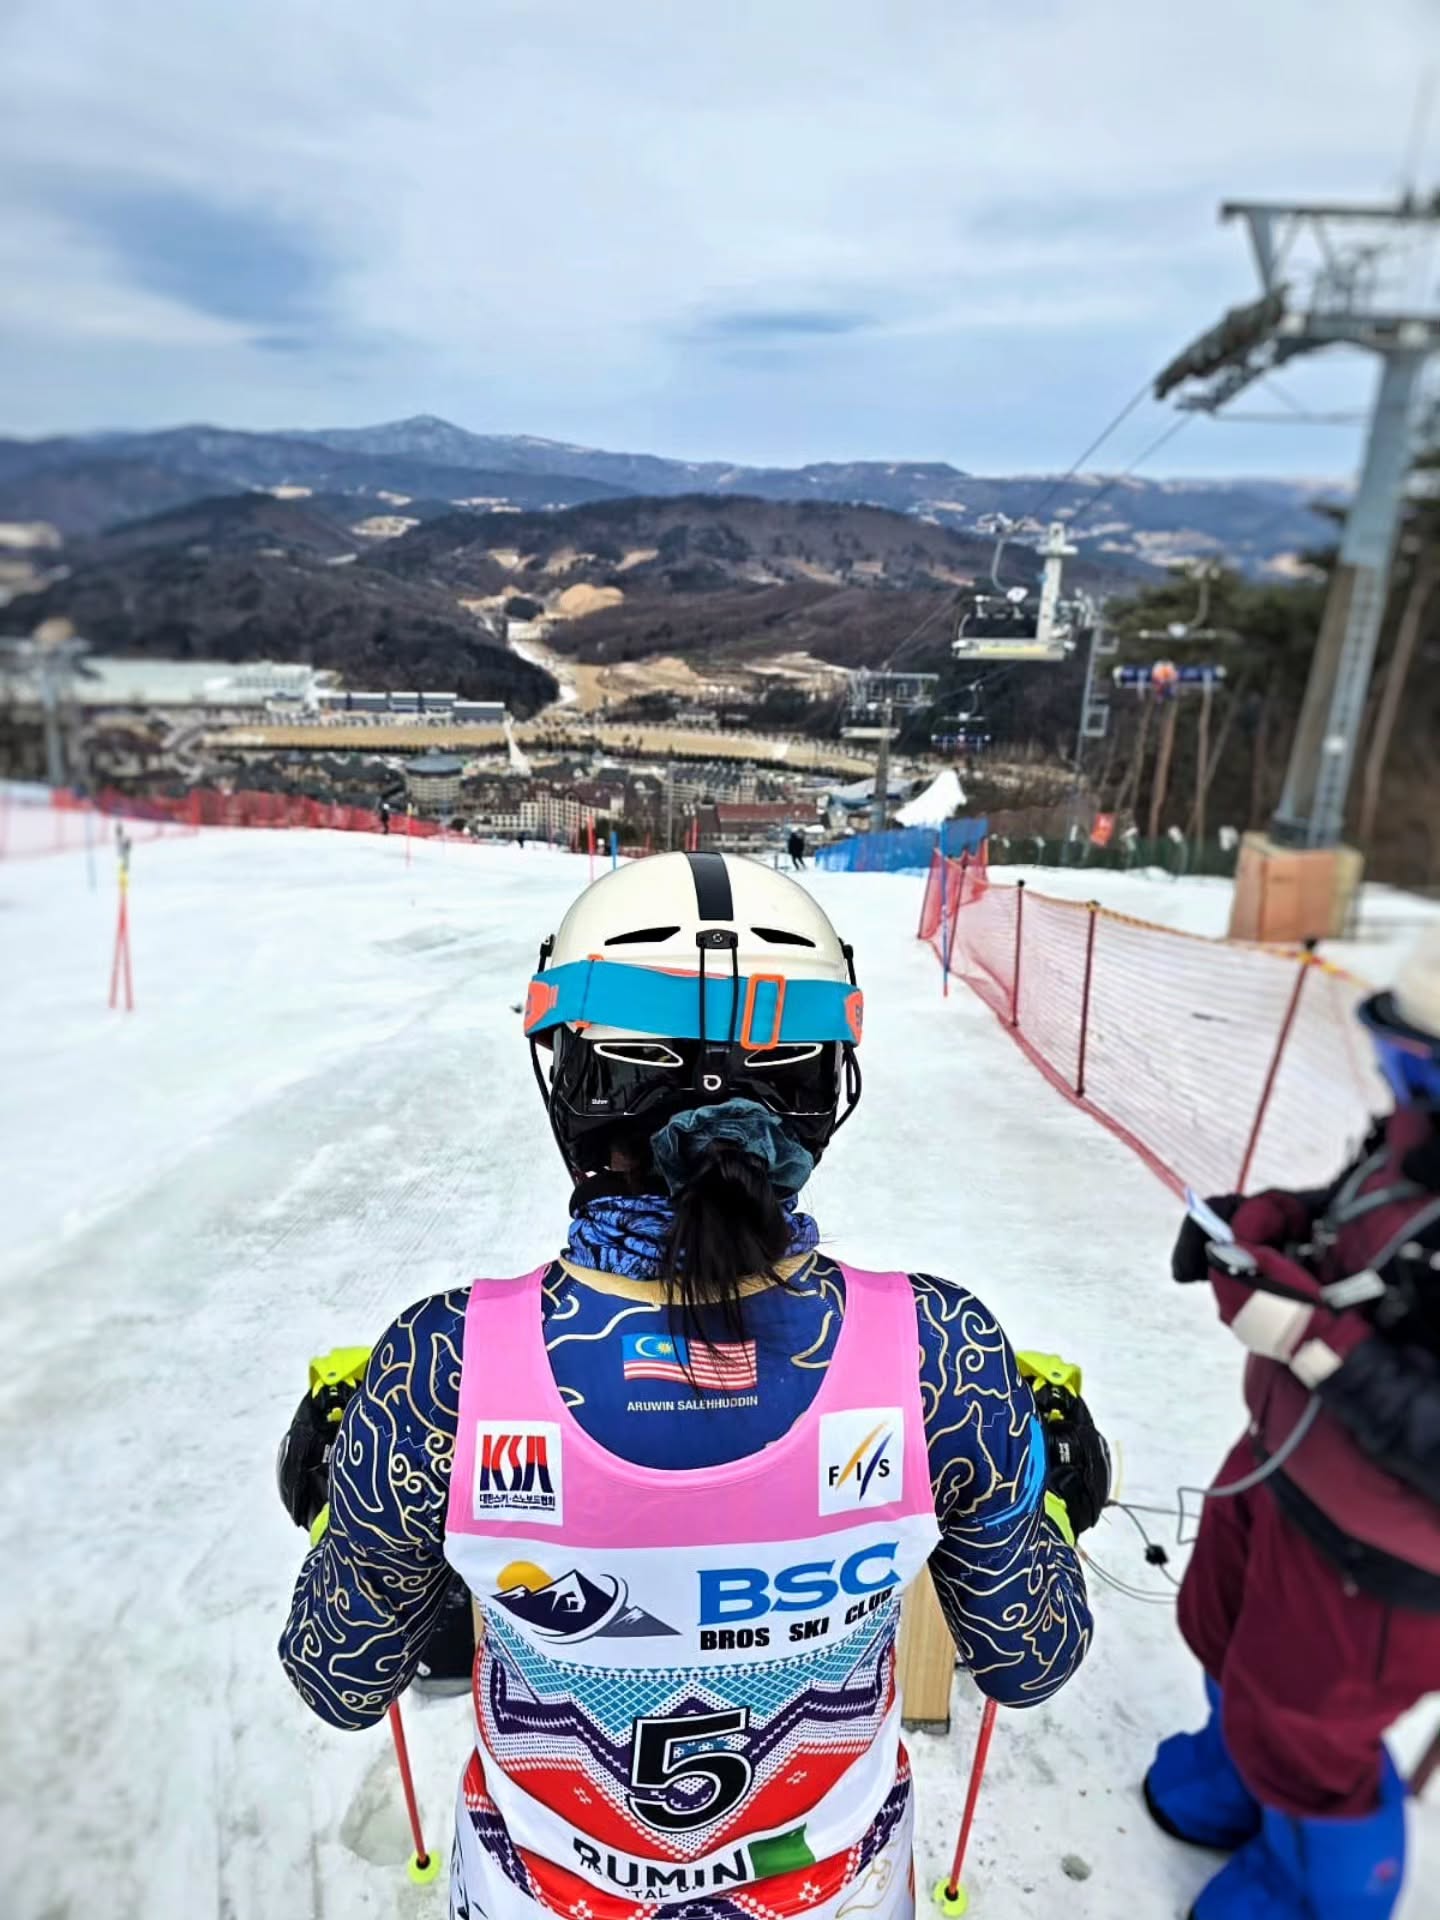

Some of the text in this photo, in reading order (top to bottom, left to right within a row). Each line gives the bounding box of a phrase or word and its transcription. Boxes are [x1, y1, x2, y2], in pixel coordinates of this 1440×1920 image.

[626, 1400, 674, 1412] ARUWIN
[480, 1434, 554, 1493] KSA
[828, 1458, 890, 1487] FIS
[697, 1541, 902, 1626] BSC
[700, 1627, 770, 1650] BROS
[788, 1616, 830, 1642] SKI
[627, 1706, 752, 1833] 5
